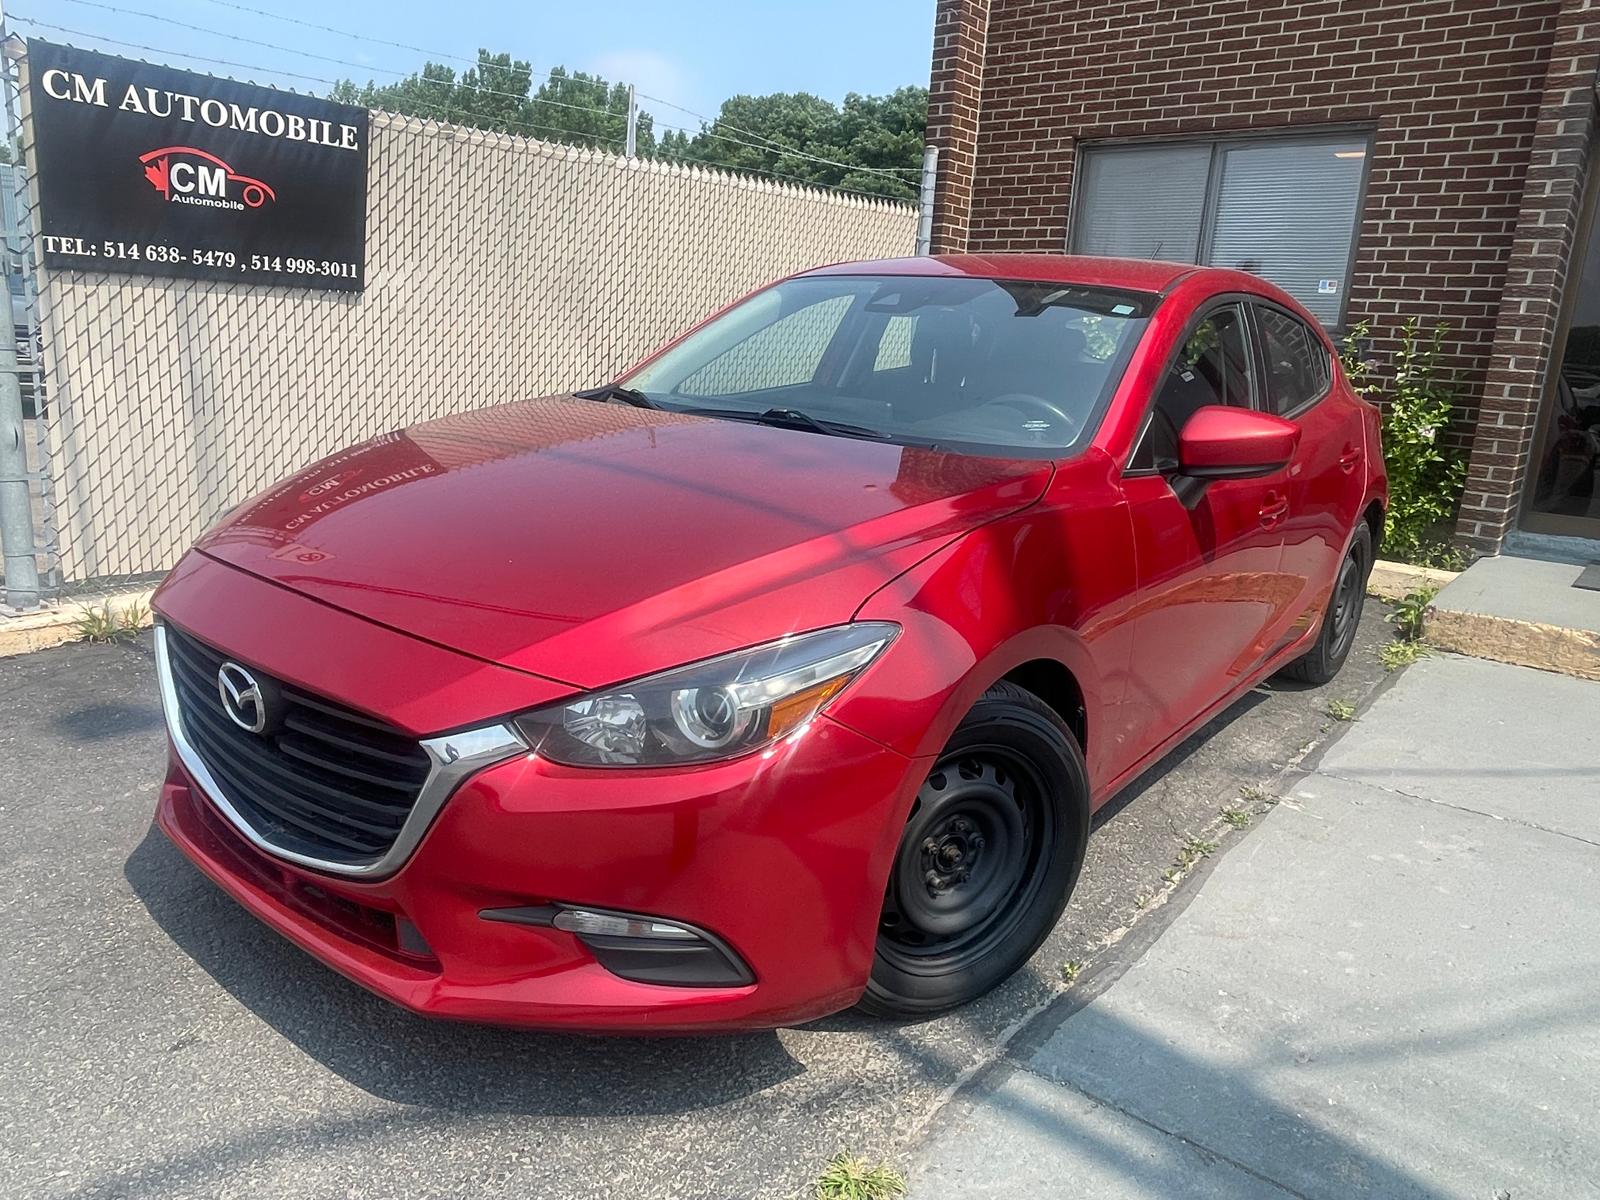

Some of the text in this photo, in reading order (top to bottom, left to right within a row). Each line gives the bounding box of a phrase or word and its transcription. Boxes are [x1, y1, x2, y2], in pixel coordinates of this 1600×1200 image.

[42, 69, 358, 150] CM AUTOMOBILE
[170, 162, 226, 197] CM
[171, 193, 244, 211] Automobile
[42, 235, 97, 257] TEL:
[103, 241, 140, 260] 514
[192, 249, 236, 268] 5479
[251, 254, 282, 272] 514
[286, 257, 358, 278] 998-3011
